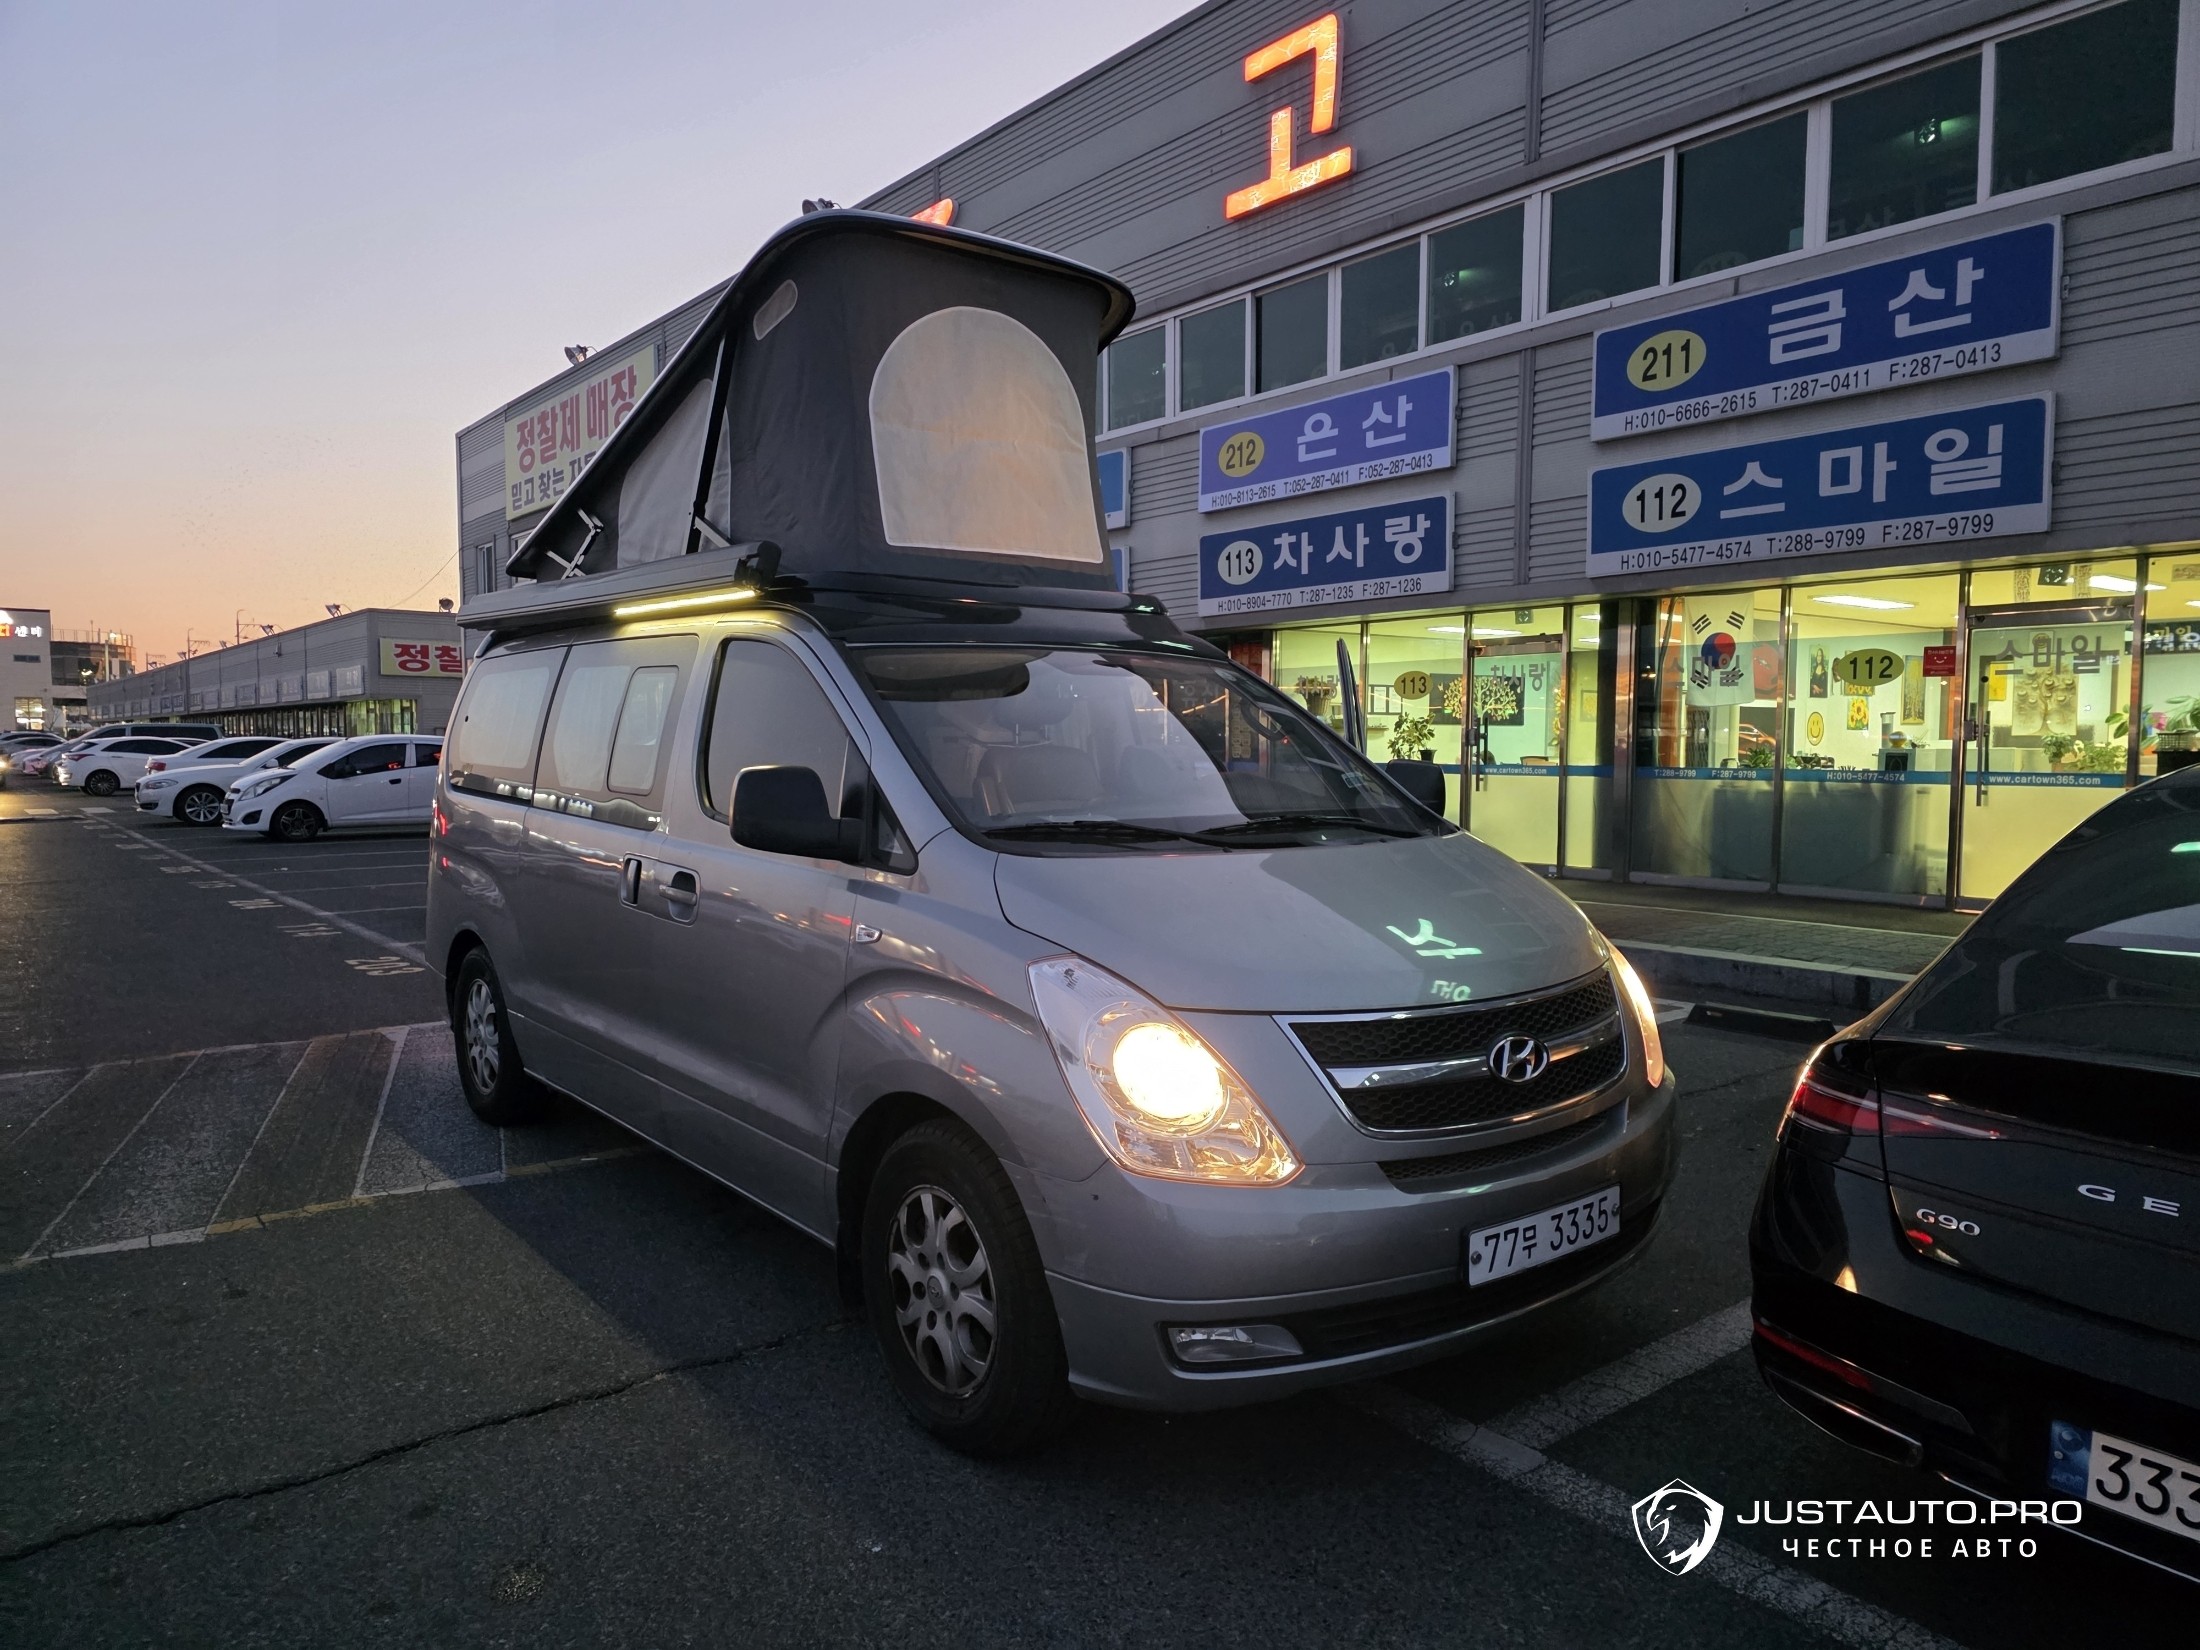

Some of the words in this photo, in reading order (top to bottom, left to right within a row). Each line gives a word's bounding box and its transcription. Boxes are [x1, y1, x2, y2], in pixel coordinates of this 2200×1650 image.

[1225, 13, 1353, 220] 고
[1642, 338, 1692, 382] 211
[1624, 391, 1757, 432] H:010-6666-2615
[1772, 369, 1870, 404] T:287-0411
[1889, 343, 2001, 382] F:287-0413
[516, 393, 580, 474] 정찰제
[586, 364, 637, 440] 매장
[1225, 438, 1257, 470] 212
[1720, 423, 2003, 520] 스마일
[511, 476, 535, 511] 믿고
[538, 468, 565, 502] 찾는
[1211, 484, 1276, 507] H:010-8113-2615
[1284, 470, 1349, 495] T:052-287-0411
[1358, 453, 1433, 480] F:052-287-0413
[1636, 483, 1687, 523] 112
[1273, 513, 1431, 575] 차사랑
[1620, 540, 1752, 570] H:010-5477-4574
[1767, 528, 1866, 554] T:288-9799
[1882, 513, 1994, 544] F:287-9799
[1225, 548, 1255, 577] 113
[1218, 592, 1292, 613] H:010-8904-7770
[1300, 585, 1354, 604] T:287-1235
[1363, 578, 1422, 597] F:287-1236
[1850, 656, 1893, 679] 112
[1995, 635, 2102, 675] 스마일
[1401, 676, 1427, 694] 113
[1485, 767, 1547, 775] www.cartown365.com
[1655, 769, 1697, 778] T:288-9799
[1712, 770, 1757, 779] F:287-9799
[1827, 771, 1905, 782] H:010-5477-4574
[1989, 775, 2101, 785] www.cartown365.com
[344, 956, 426, 976] 203
[1484, 1227, 1537, 1273] 77무
[1550, 1196, 1608, 1251] 3335
[1916, 1208, 1981, 1236] G90
[2096, 1444, 2200, 1530] 333
